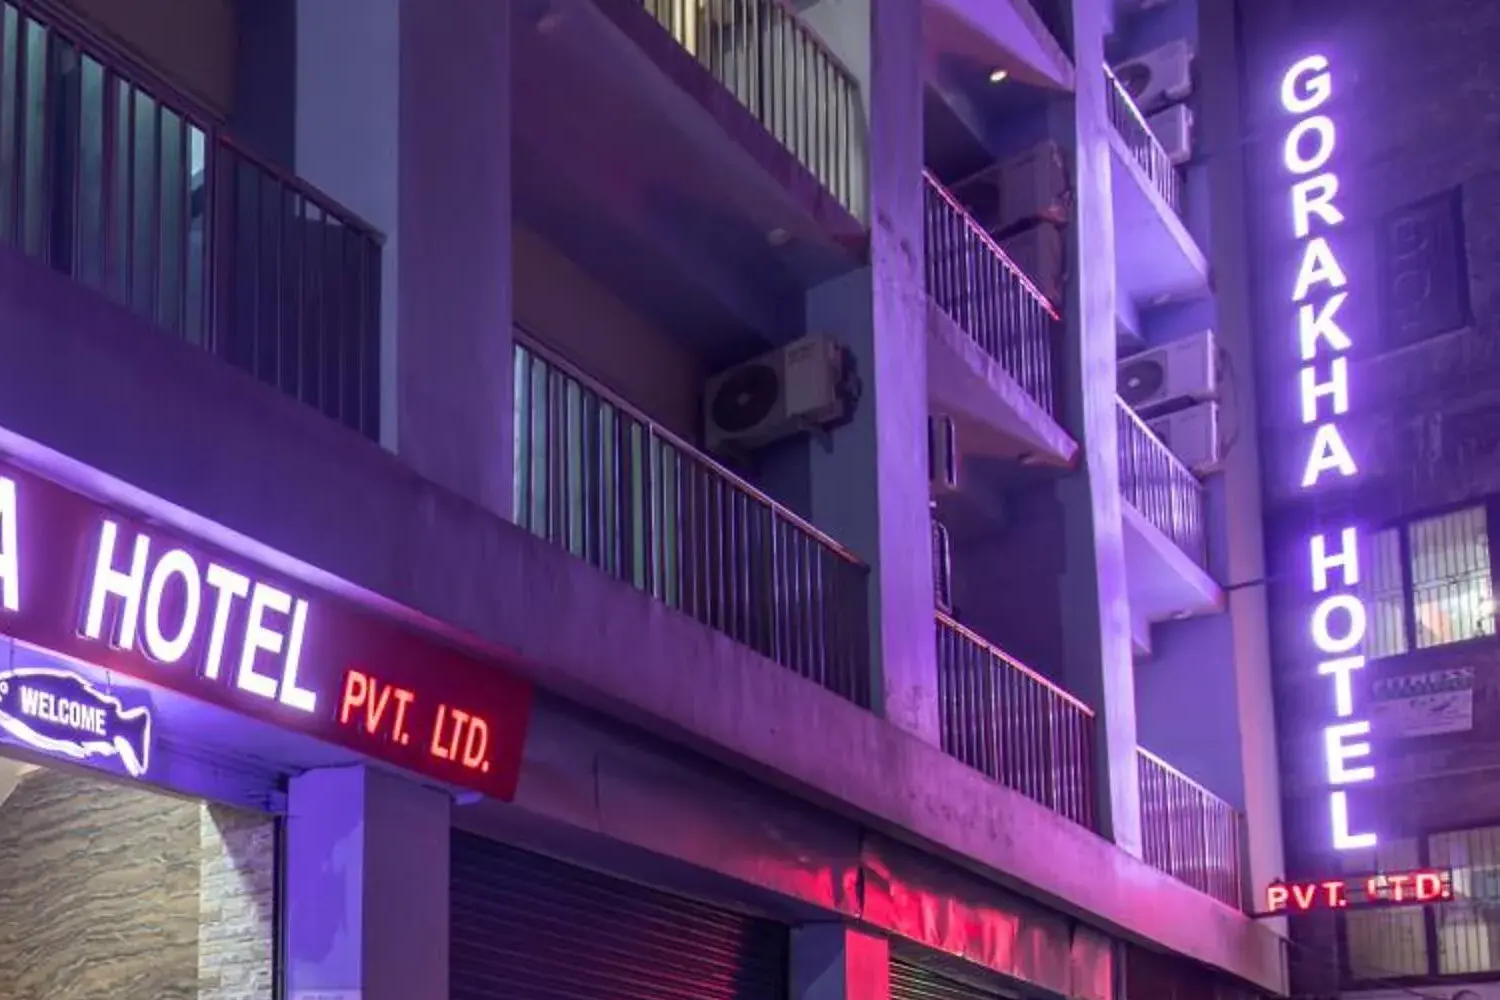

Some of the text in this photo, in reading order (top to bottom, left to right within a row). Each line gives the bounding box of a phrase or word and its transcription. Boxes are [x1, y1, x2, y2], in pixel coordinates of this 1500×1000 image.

[1280, 54, 1378, 851] GORAKHA HOTEL
[19, 684, 108, 737] WELCOME
[82, 518, 318, 713] HOTEL
[339, 668, 416, 746] PVT.
[429, 703, 491, 773] LTD.
[1267, 881, 1347, 912] PVT.
